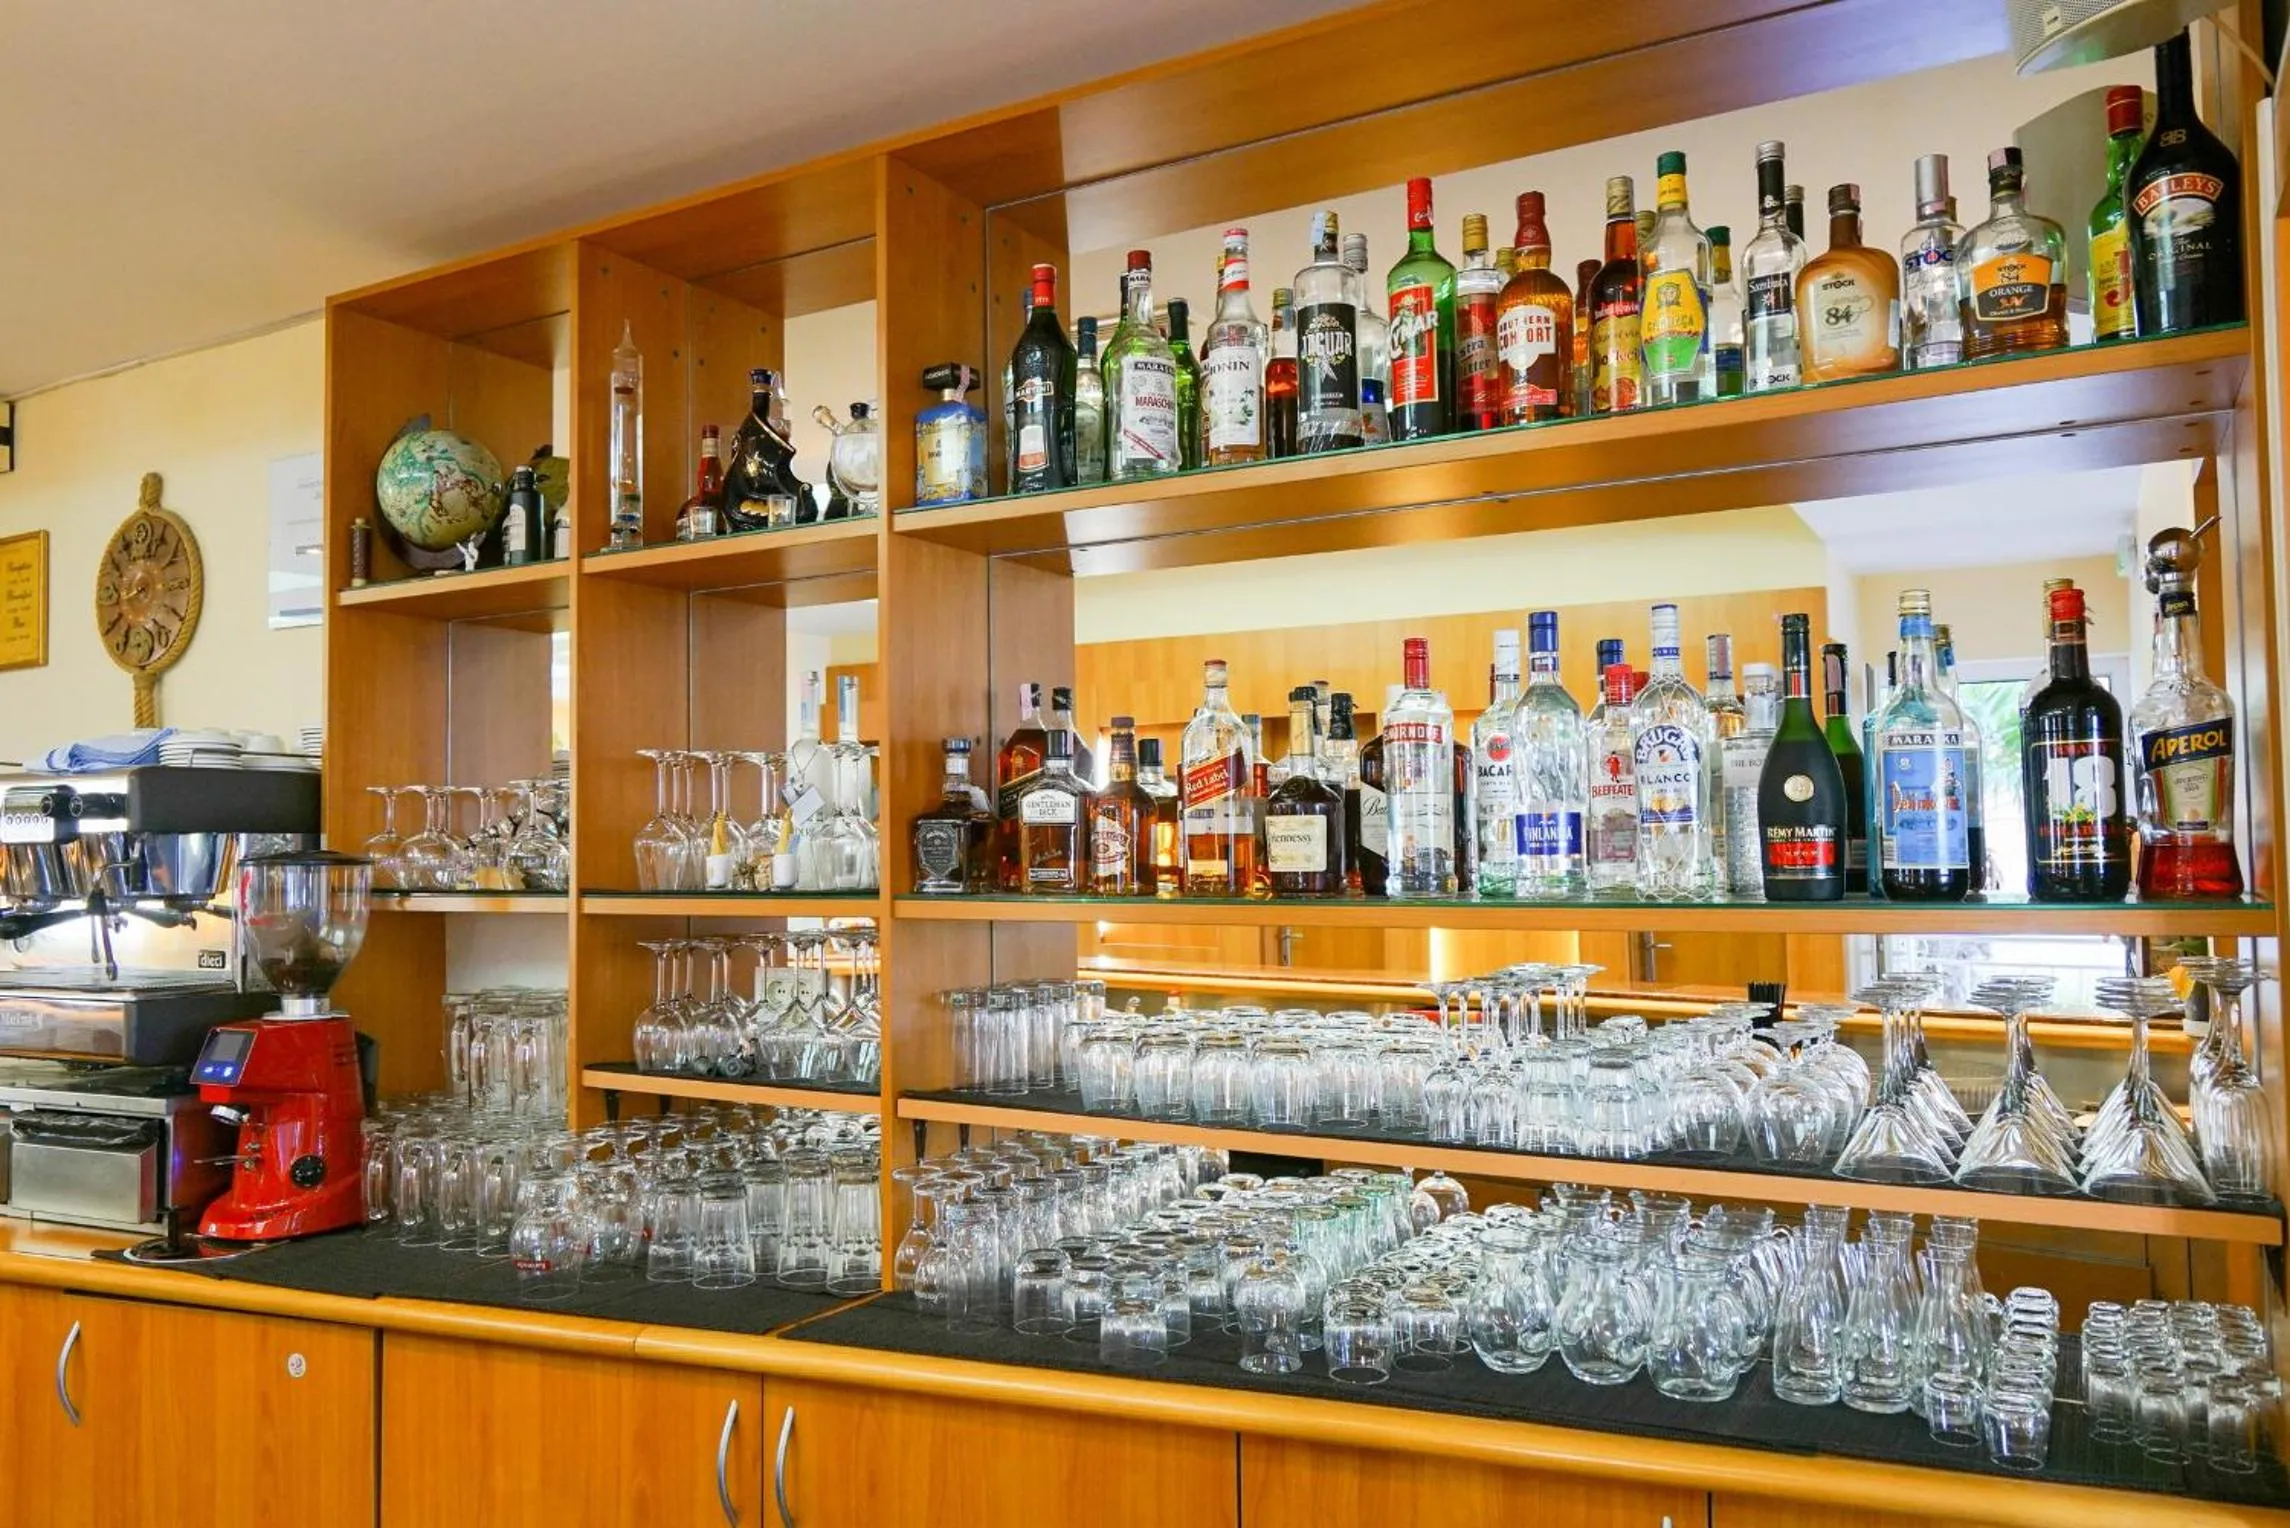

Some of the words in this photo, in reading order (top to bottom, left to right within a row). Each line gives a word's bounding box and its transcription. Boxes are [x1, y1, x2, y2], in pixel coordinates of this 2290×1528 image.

[1822, 279, 1856, 291] STOCK
[1989, 285, 2034, 298] ORANGE
[1751, 373, 1791, 385] SOCK
[1891, 735, 1959, 745] MARAKA
[2150, 731, 2228, 764] APEROL
[1185, 778, 1202, 794] Red
[2042, 755, 2117, 819] 18
[1794, 825, 1834, 838] MARTIN
